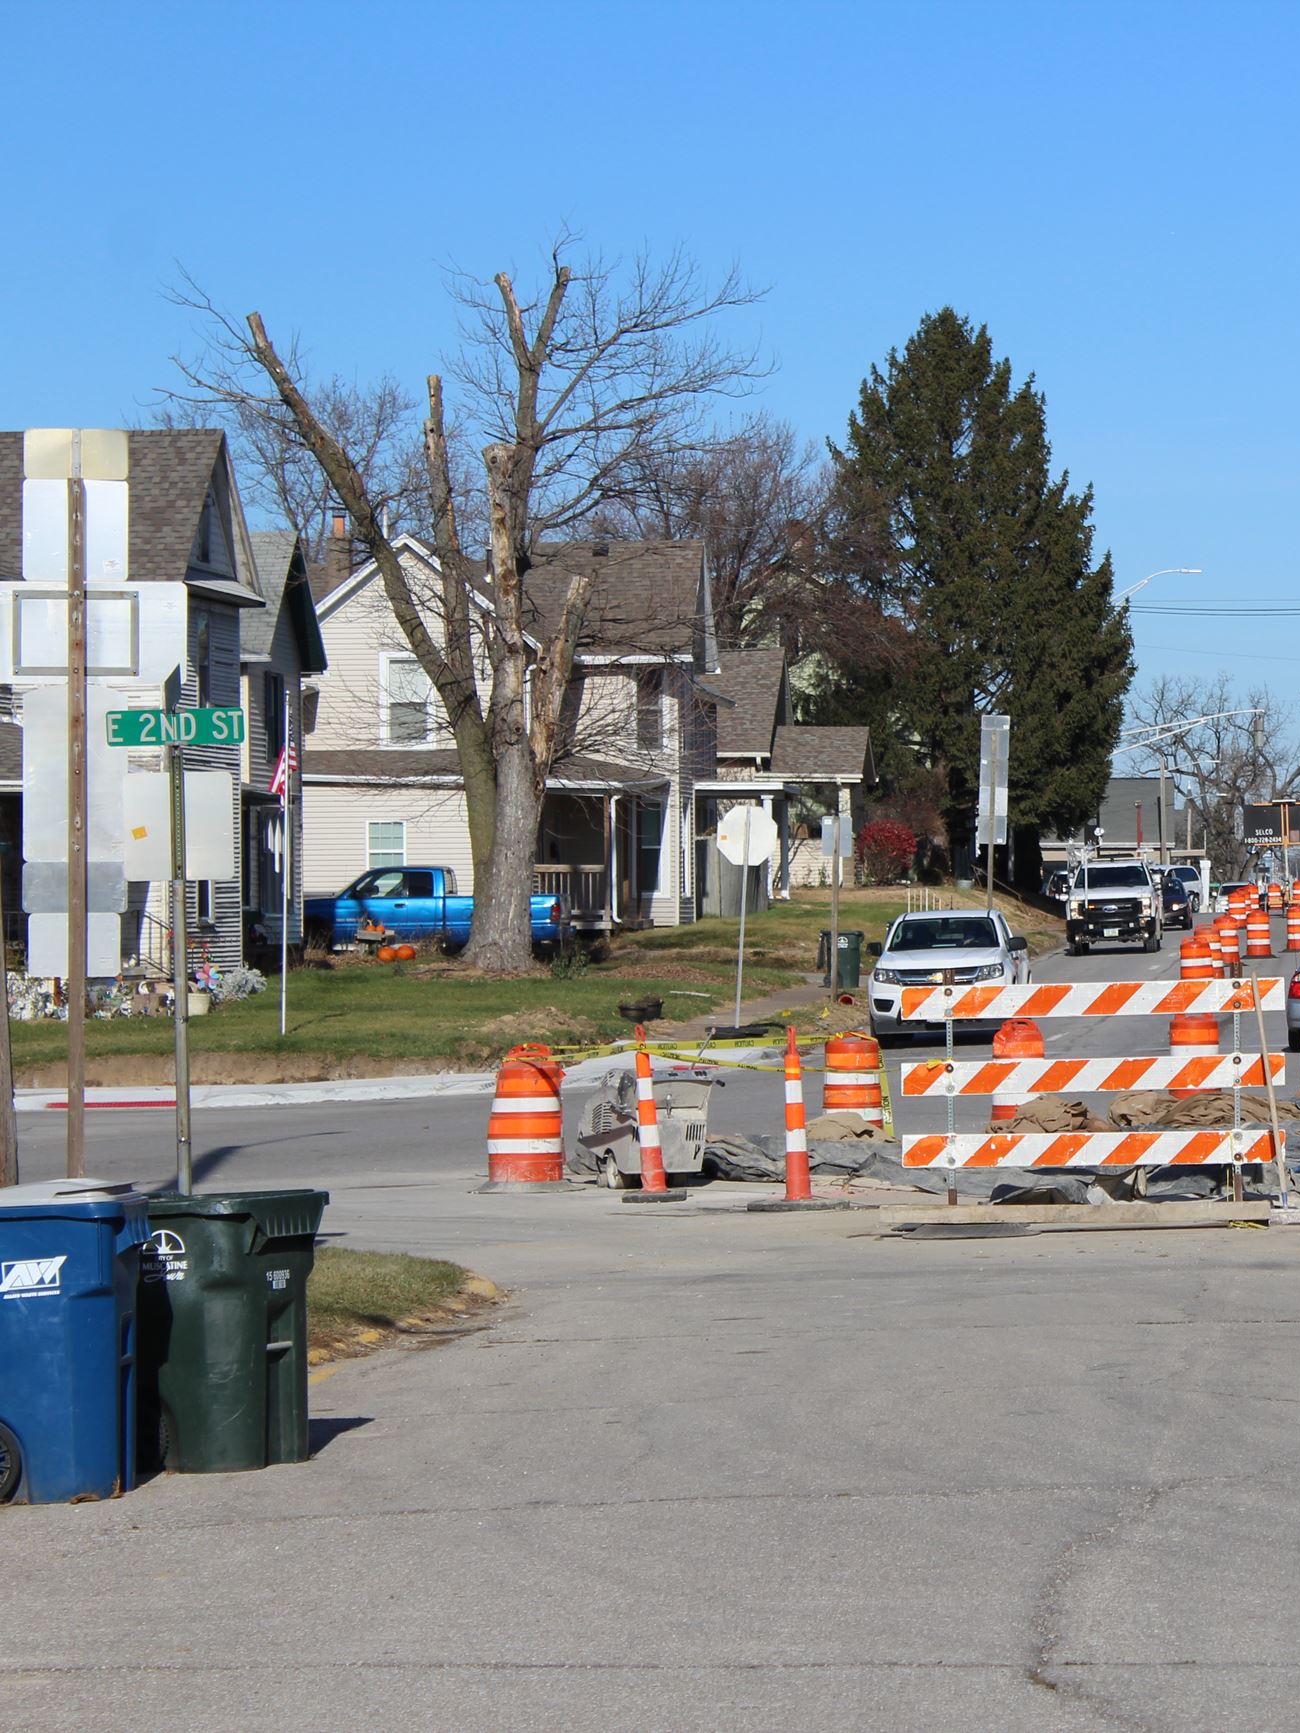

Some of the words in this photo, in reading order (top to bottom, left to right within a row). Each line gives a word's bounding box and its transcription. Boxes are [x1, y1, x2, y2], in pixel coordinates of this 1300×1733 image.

[107, 713, 123, 742] E
[138, 712, 196, 742] 2ND
[211, 711, 242, 739] ST
[1255, 828, 1273, 836] SELCO
